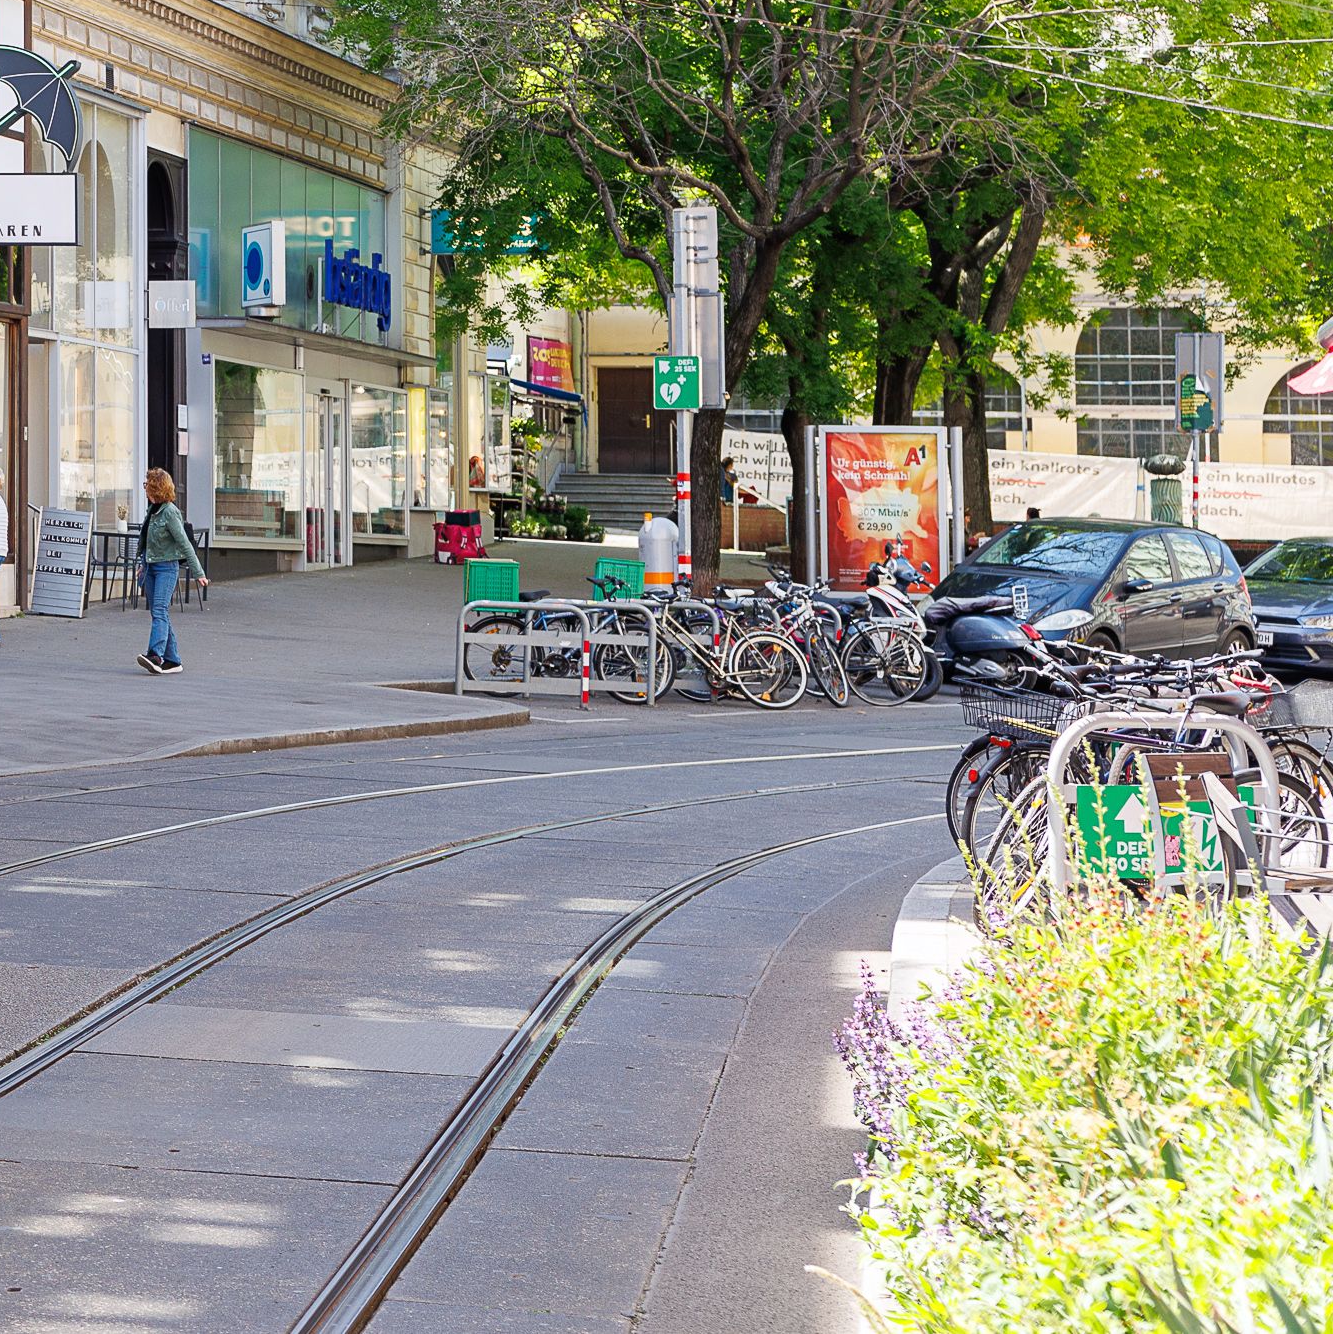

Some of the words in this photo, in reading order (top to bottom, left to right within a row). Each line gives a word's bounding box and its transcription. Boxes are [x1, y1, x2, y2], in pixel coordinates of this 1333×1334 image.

[674, 365, 683, 373] 25
[683, 365, 697, 373] SEK
[729, 439, 749, 451] Ich
[837, 458, 850, 468] Ur
[991, 457, 1015, 470] ein
[1021, 459, 1101, 476] knallrotes
[837, 470, 860, 480] kein
[1206, 470, 1230, 482] ein
[1236, 471, 1316, 486] knallrotes
[45, 519, 83, 529] HERZLICH
[858, 522, 865, 531] €
[866, 522, 893, 532] 29,90
[46, 549, 62, 558] BEI
[1116, 841, 1148, 855] DEF
